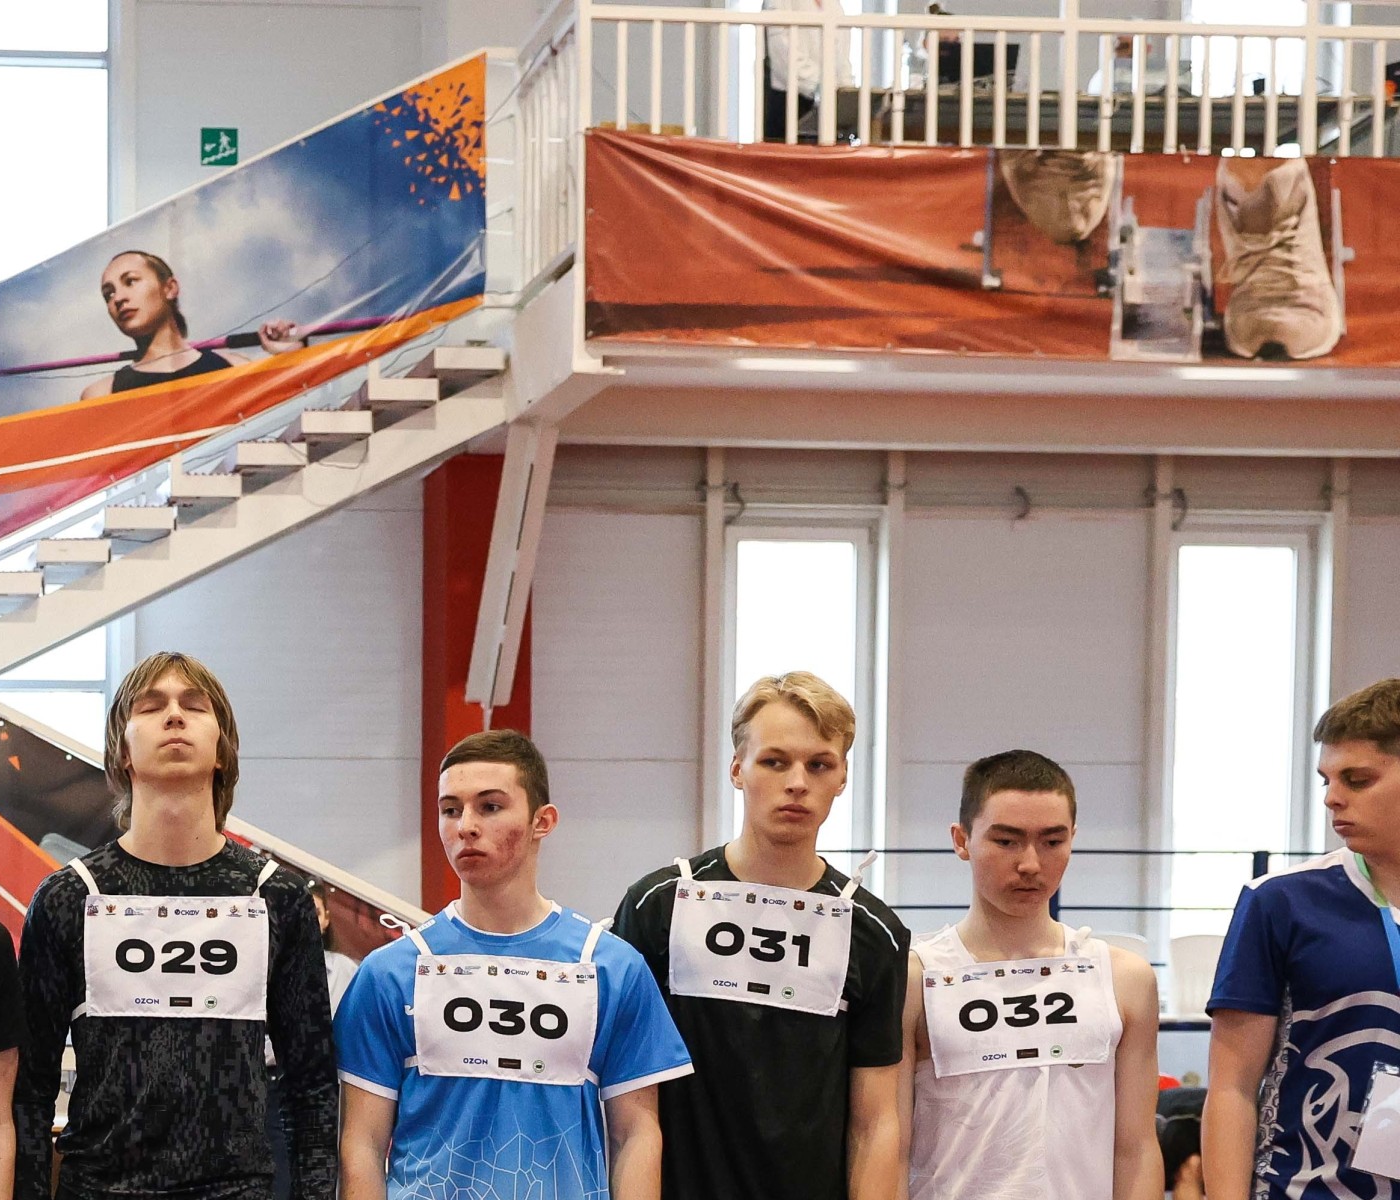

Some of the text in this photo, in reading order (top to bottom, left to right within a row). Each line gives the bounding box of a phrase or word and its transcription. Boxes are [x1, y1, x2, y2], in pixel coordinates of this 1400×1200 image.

[116, 939, 237, 975] 029
[706, 922, 810, 967] 031
[712, 980, 738, 988] OZON
[444, 998, 568, 1039] 030
[959, 993, 1077, 1032] 032
[462, 1058, 488, 1066] OZON
[982, 1052, 1007, 1061] OZON
